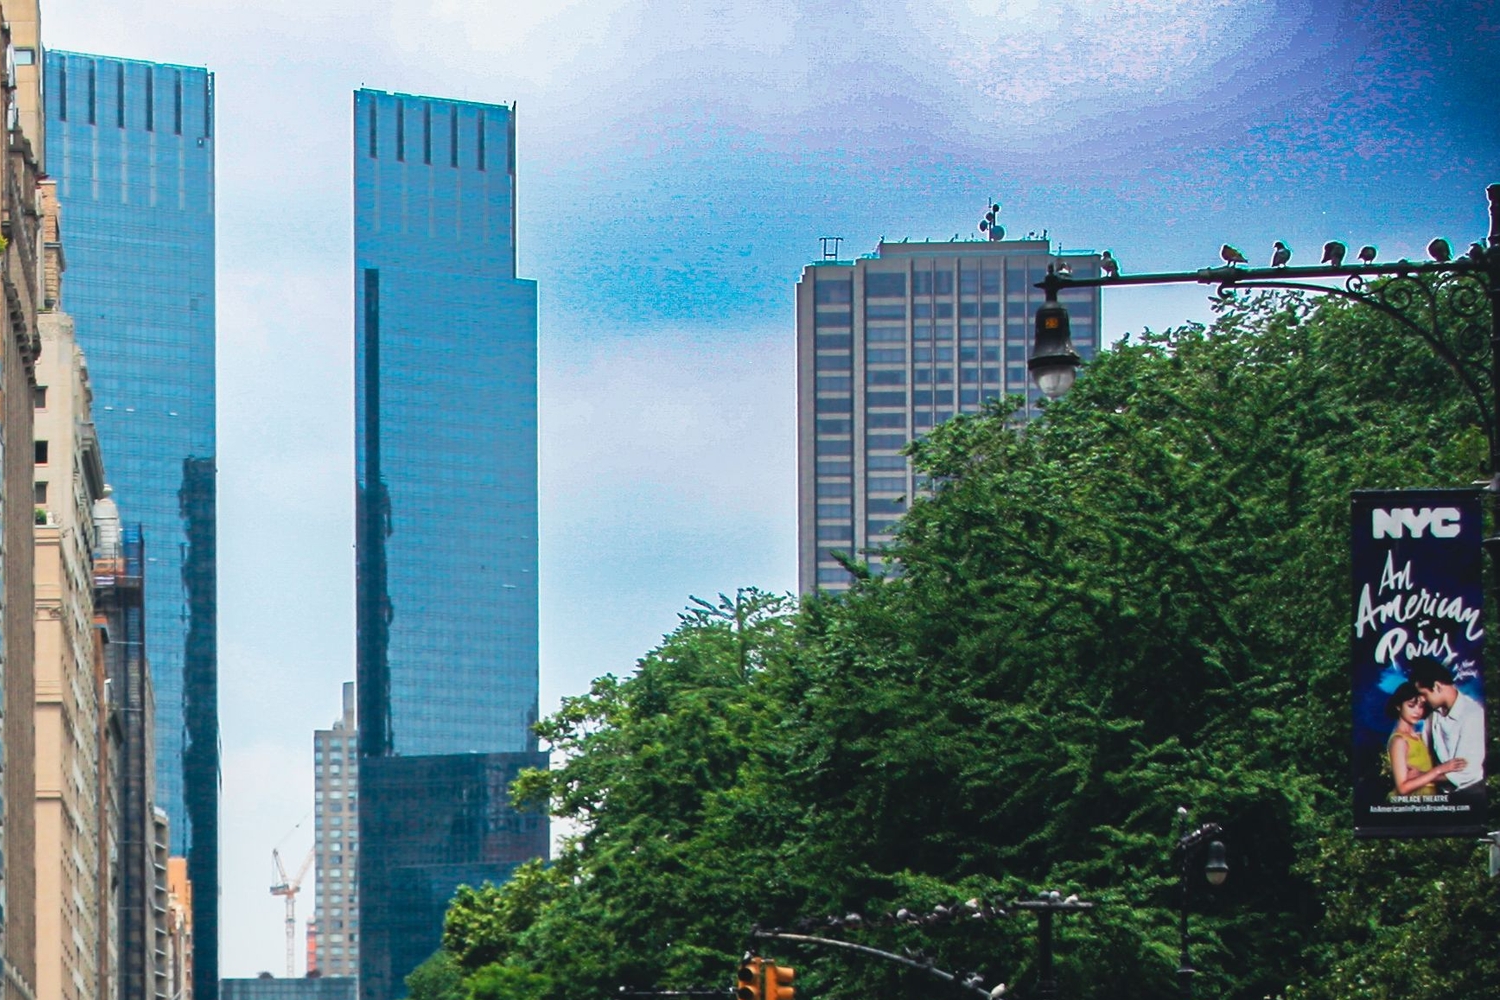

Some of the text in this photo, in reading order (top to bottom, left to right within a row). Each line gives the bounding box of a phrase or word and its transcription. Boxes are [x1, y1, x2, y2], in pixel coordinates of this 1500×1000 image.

[1372, 508, 1461, 539] NYC
[1378, 549, 1414, 596] An
[1354, 583, 1484, 641] American
[1375, 627, 1458, 671] Paris
